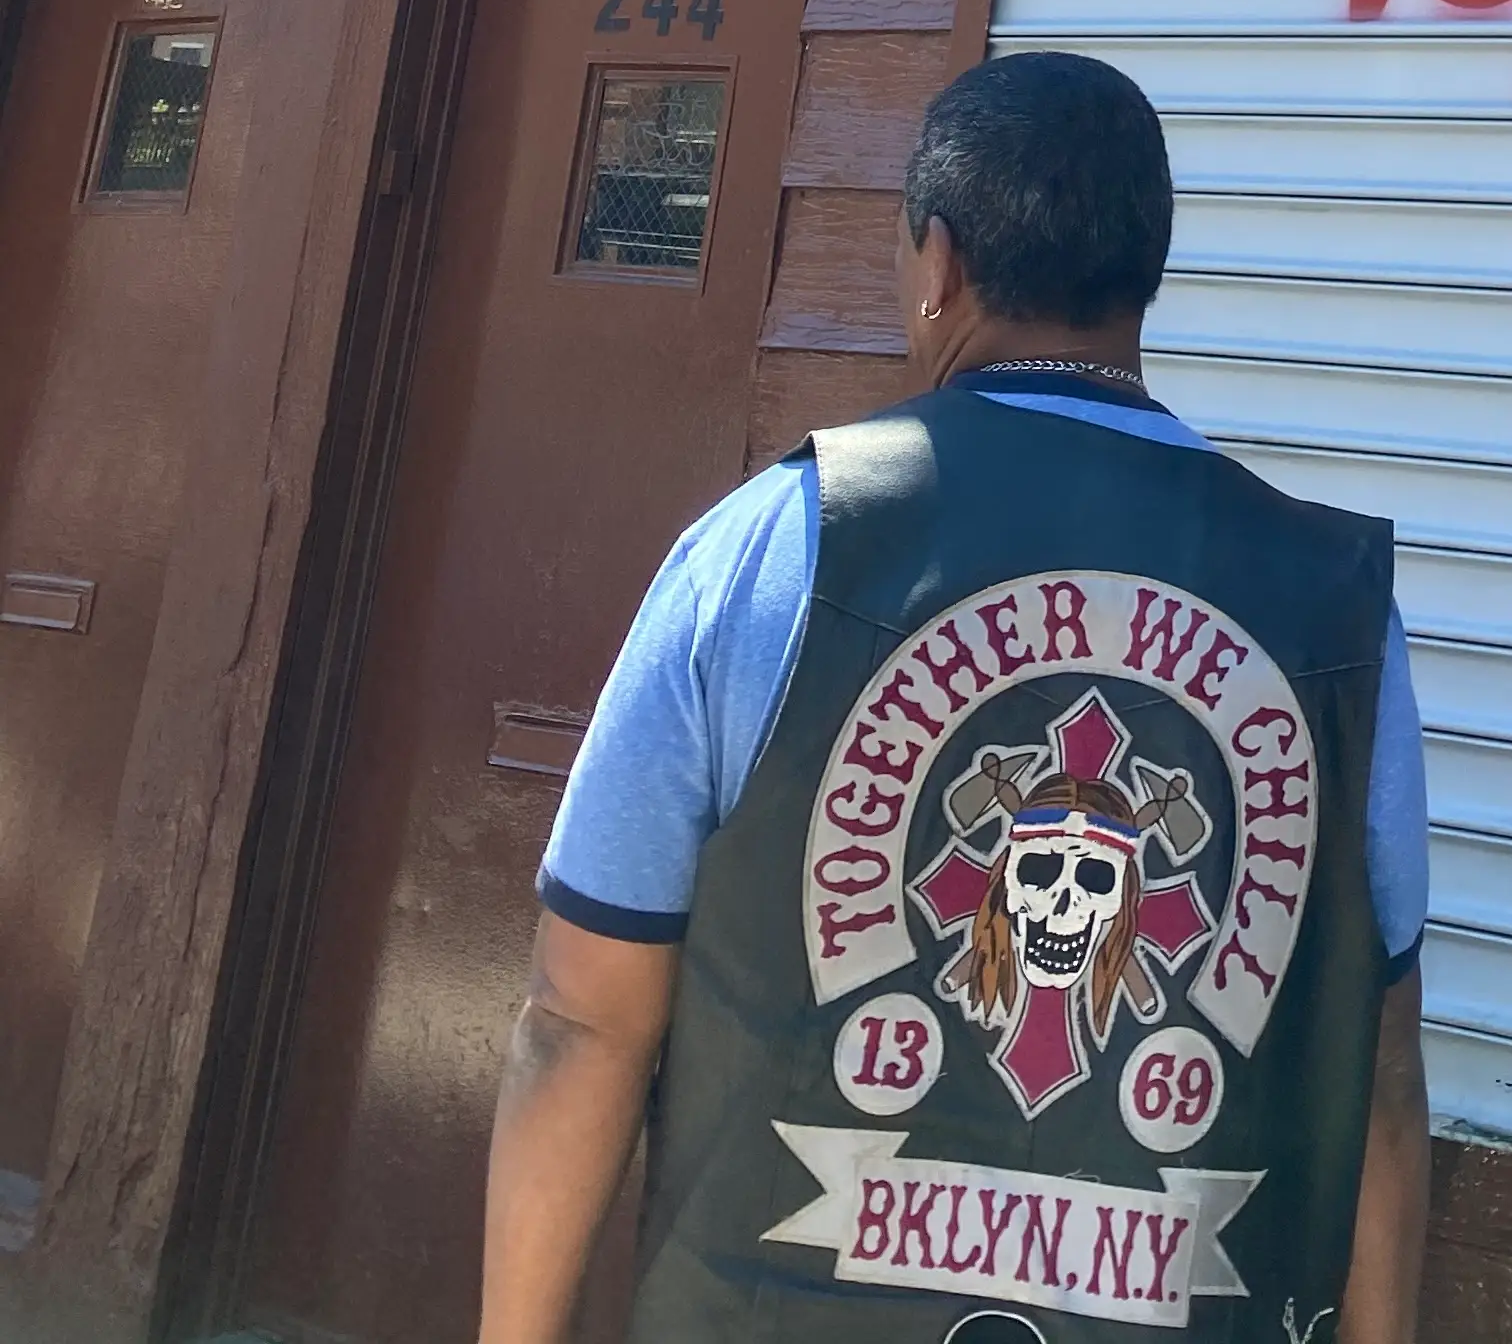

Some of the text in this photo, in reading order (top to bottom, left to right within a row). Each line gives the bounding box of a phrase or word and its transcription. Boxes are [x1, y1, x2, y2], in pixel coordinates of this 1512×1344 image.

[1122, 588, 1249, 711] WE
[813, 580, 1094, 960] TOGETHER
[1212, 706, 1310, 1000] CHILL
[852, 1016, 930, 1090] 13
[1132, 1051, 1214, 1126] 69
